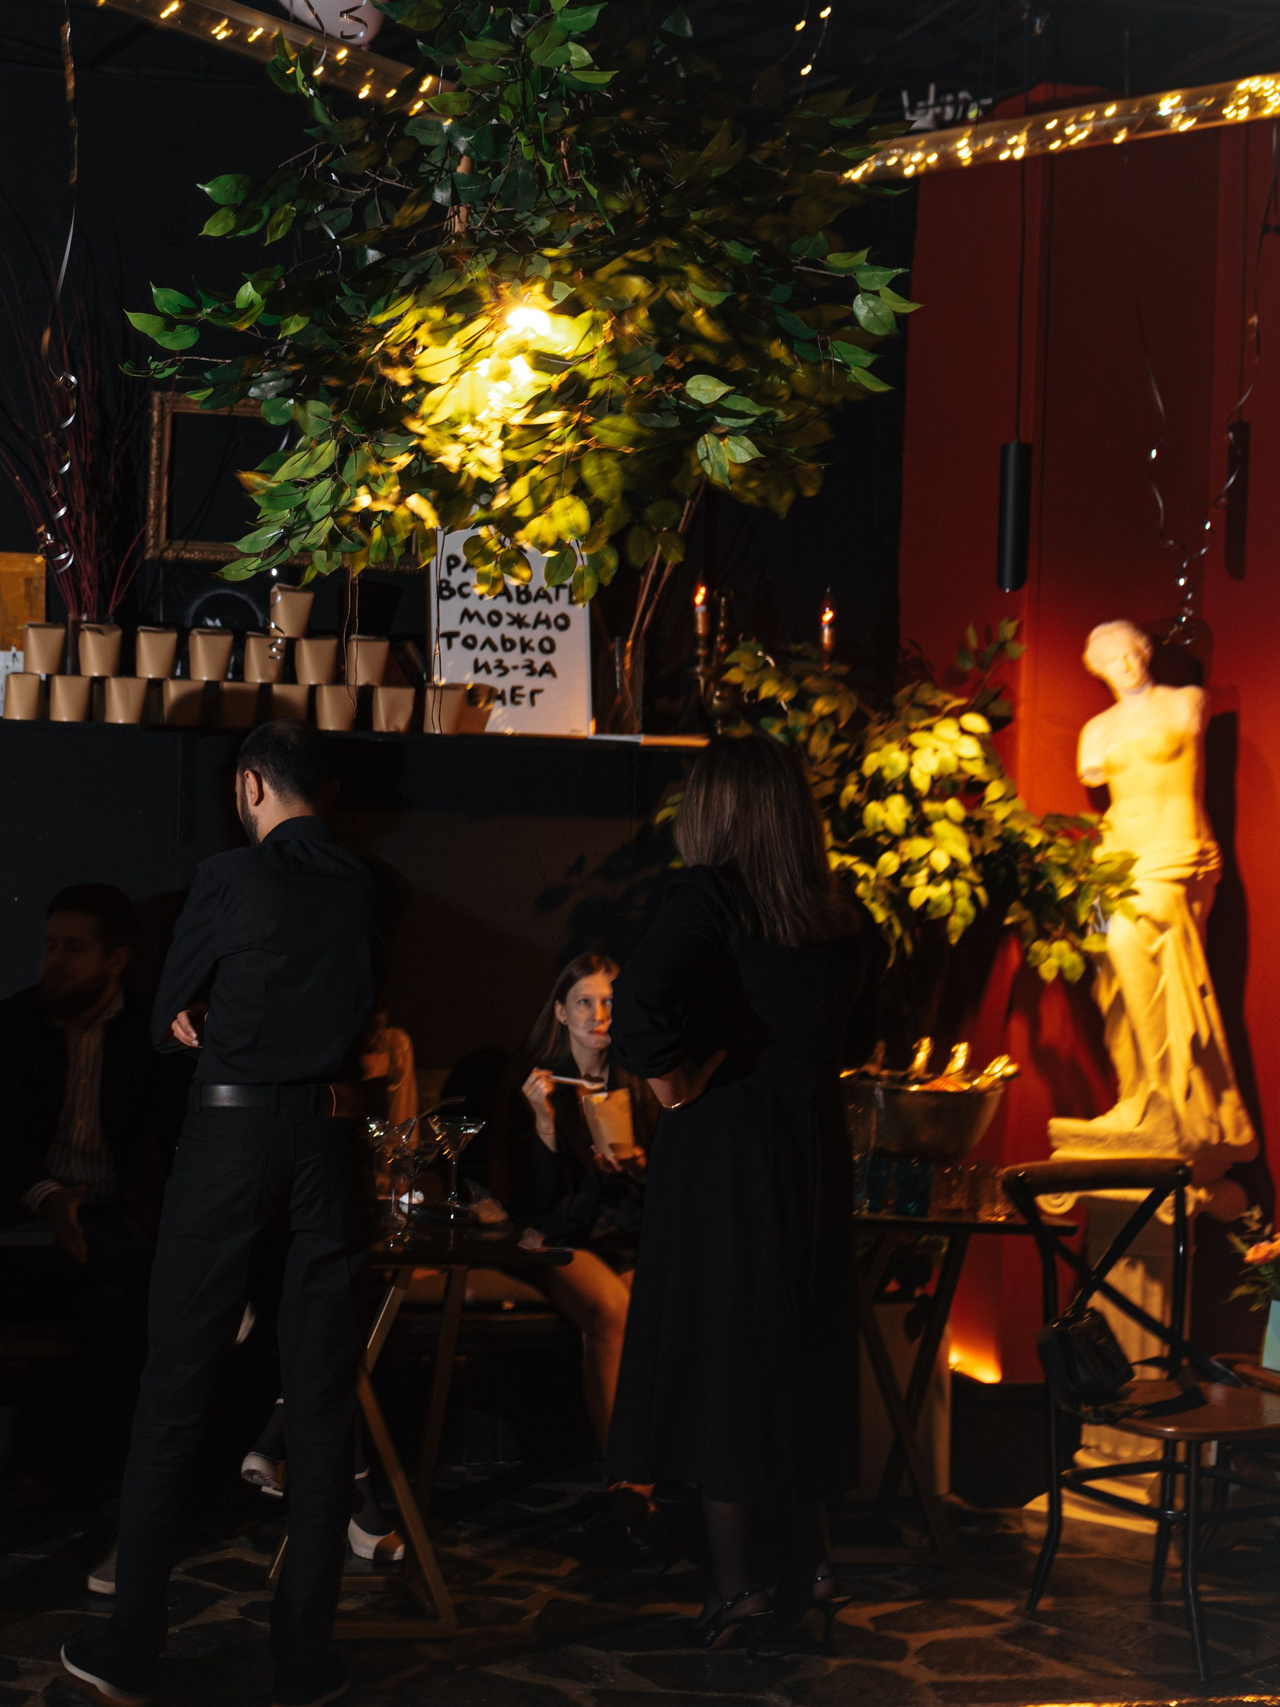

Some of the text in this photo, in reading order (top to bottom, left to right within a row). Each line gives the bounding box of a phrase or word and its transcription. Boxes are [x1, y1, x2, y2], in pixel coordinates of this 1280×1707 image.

[459, 607, 570, 631] МОЖНО
[440, 630, 556, 655] ТОЛЬКО
[473, 657, 557, 678] ИЗ-ЗА
